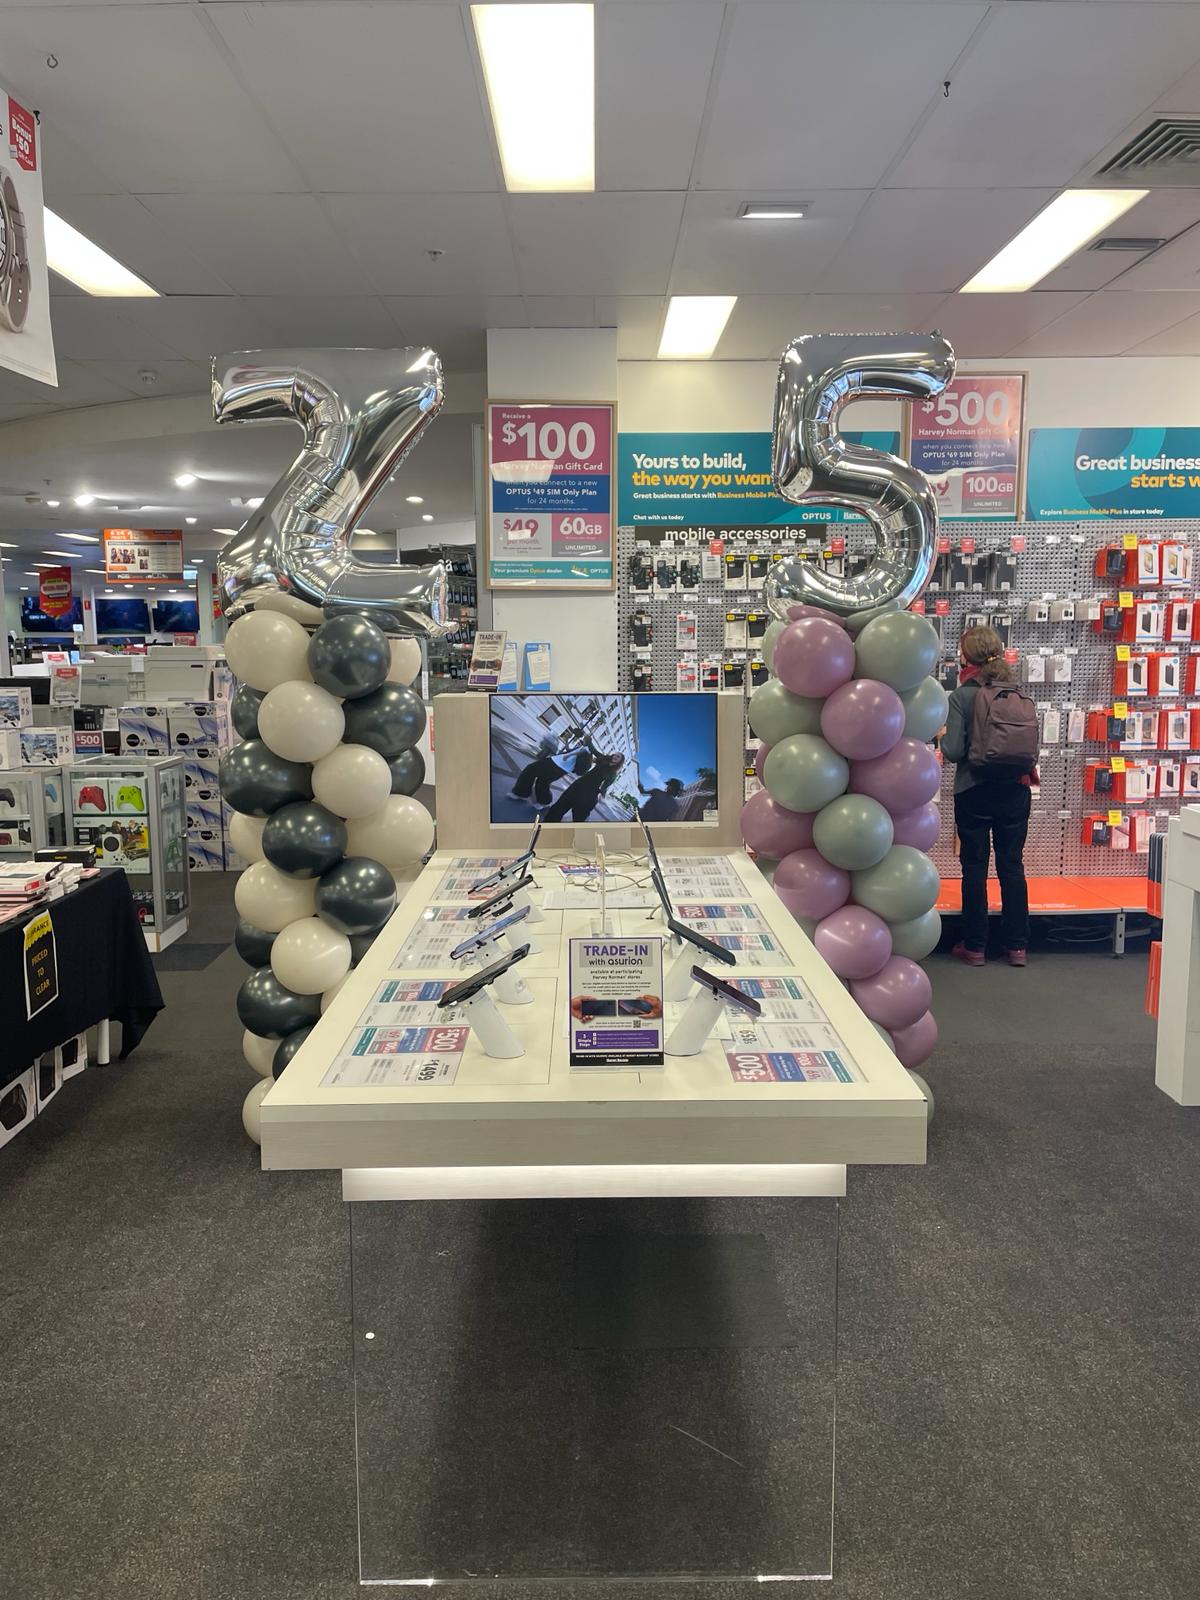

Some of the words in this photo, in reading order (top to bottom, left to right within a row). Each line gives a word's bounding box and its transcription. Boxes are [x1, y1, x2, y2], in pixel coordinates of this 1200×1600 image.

[922, 391, 1009, 426] $500
[502, 421, 596, 460] $100
[919, 429, 944, 437] Harvey
[632, 453, 679, 469] Yours
[681, 454, 700, 469] to
[703, 452, 747, 471] build,
[974, 452, 989, 460] Only
[1076, 454, 1128, 471] Great
[565, 462, 581, 471] Gift
[583, 462, 603, 471] Card
[632, 470, 660, 486] the
[663, 474, 700, 489] way
[702, 474, 732, 489] you
[734, 474, 774, 486] wan
[966, 476, 1014, 494] 100GB
[1130, 473, 1185, 488] starts
[562, 488, 580, 497] Only
[582, 488, 598, 496] Plan
[802, 512, 831, 520] OPTUS
[559, 517, 603, 536] 60GB
[665, 527, 715, 541] mobile
[719, 526, 807, 540] accessories
[77, 735, 101, 745] $500
[32, 948, 49, 966] PRICED
[583, 945, 649, 957] TRADE-IN
[588, 957, 605, 966] with
[607, 956, 643, 966] asurion
[37, 967, 45, 977] TO
[36, 979, 50, 996] CLEAR
